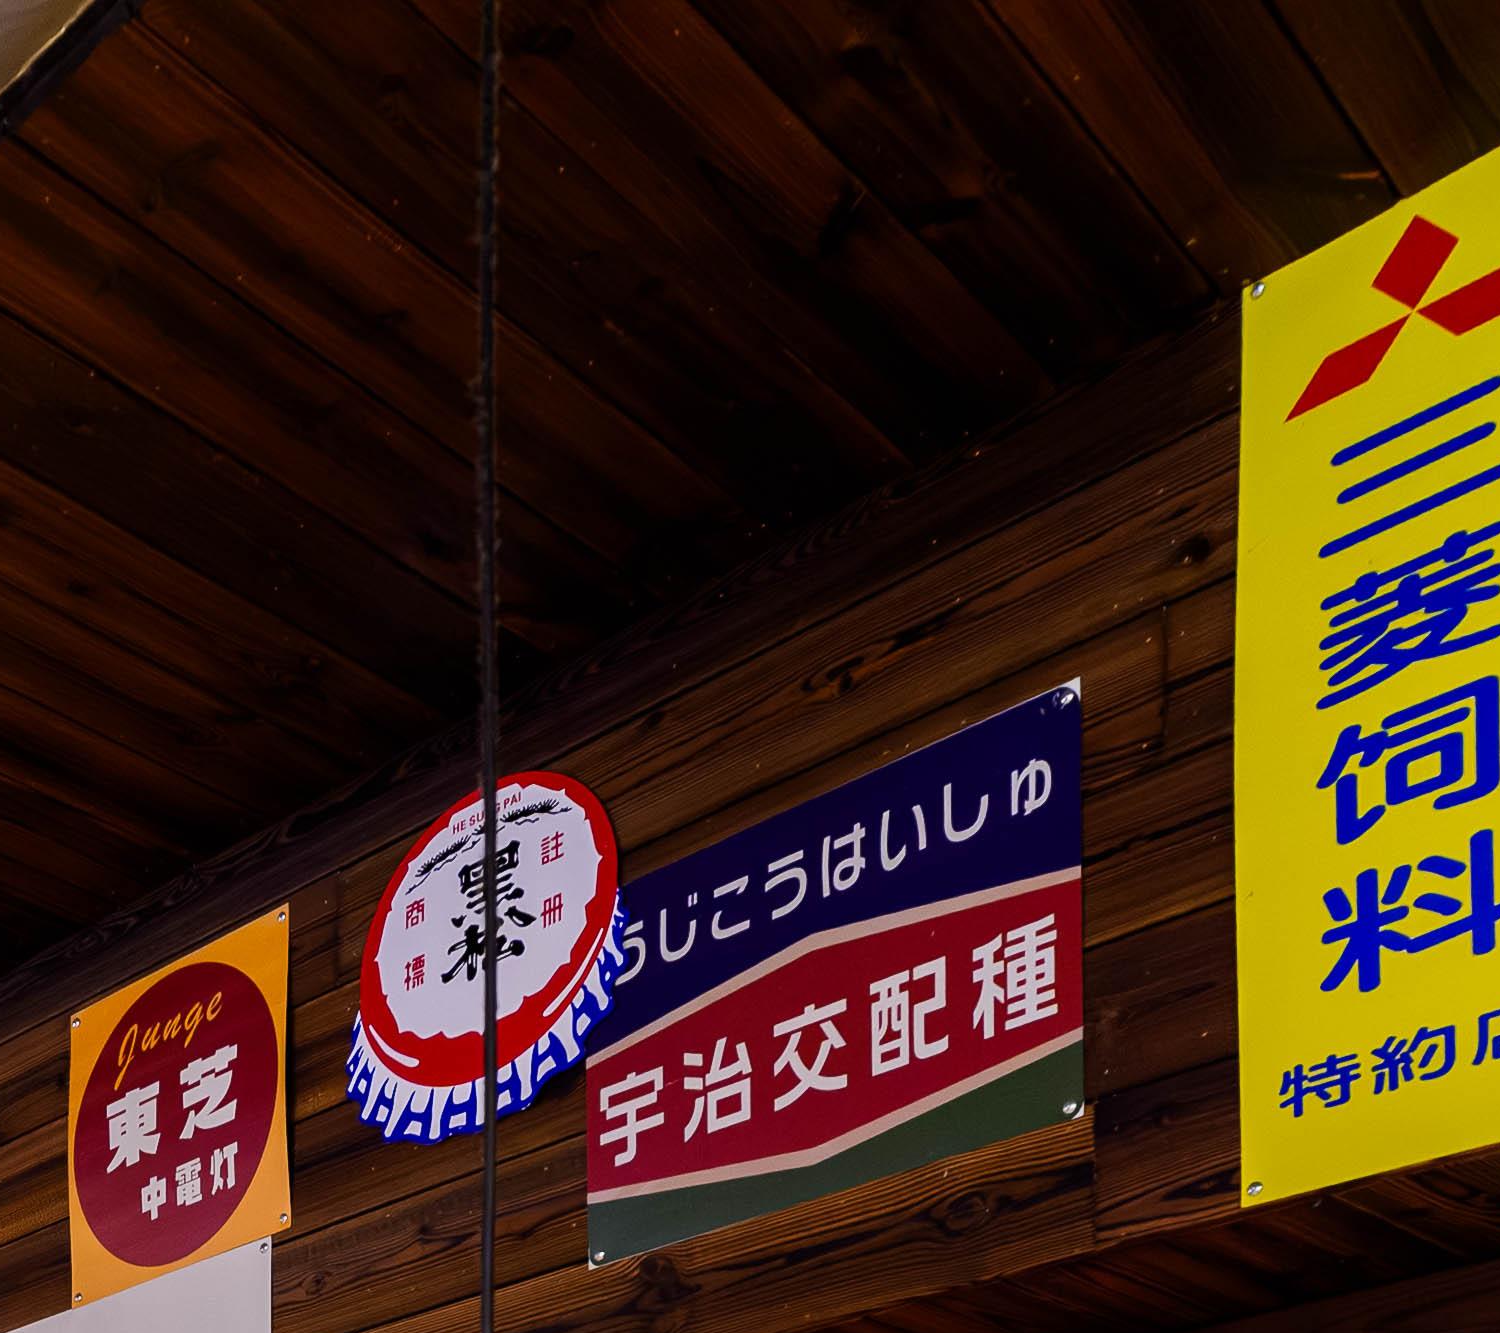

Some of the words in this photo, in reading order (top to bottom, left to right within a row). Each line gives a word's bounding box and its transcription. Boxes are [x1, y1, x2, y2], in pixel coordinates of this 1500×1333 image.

[452, 819, 466, 835] HE
[503, 791, 522, 809] PAI
[404, 897, 425, 991] 商標
[598, 912, 1059, 1169] 宇治交配種
[106, 1043, 239, 1175] 東芝
[140, 1141, 238, 1221] 中電灯
